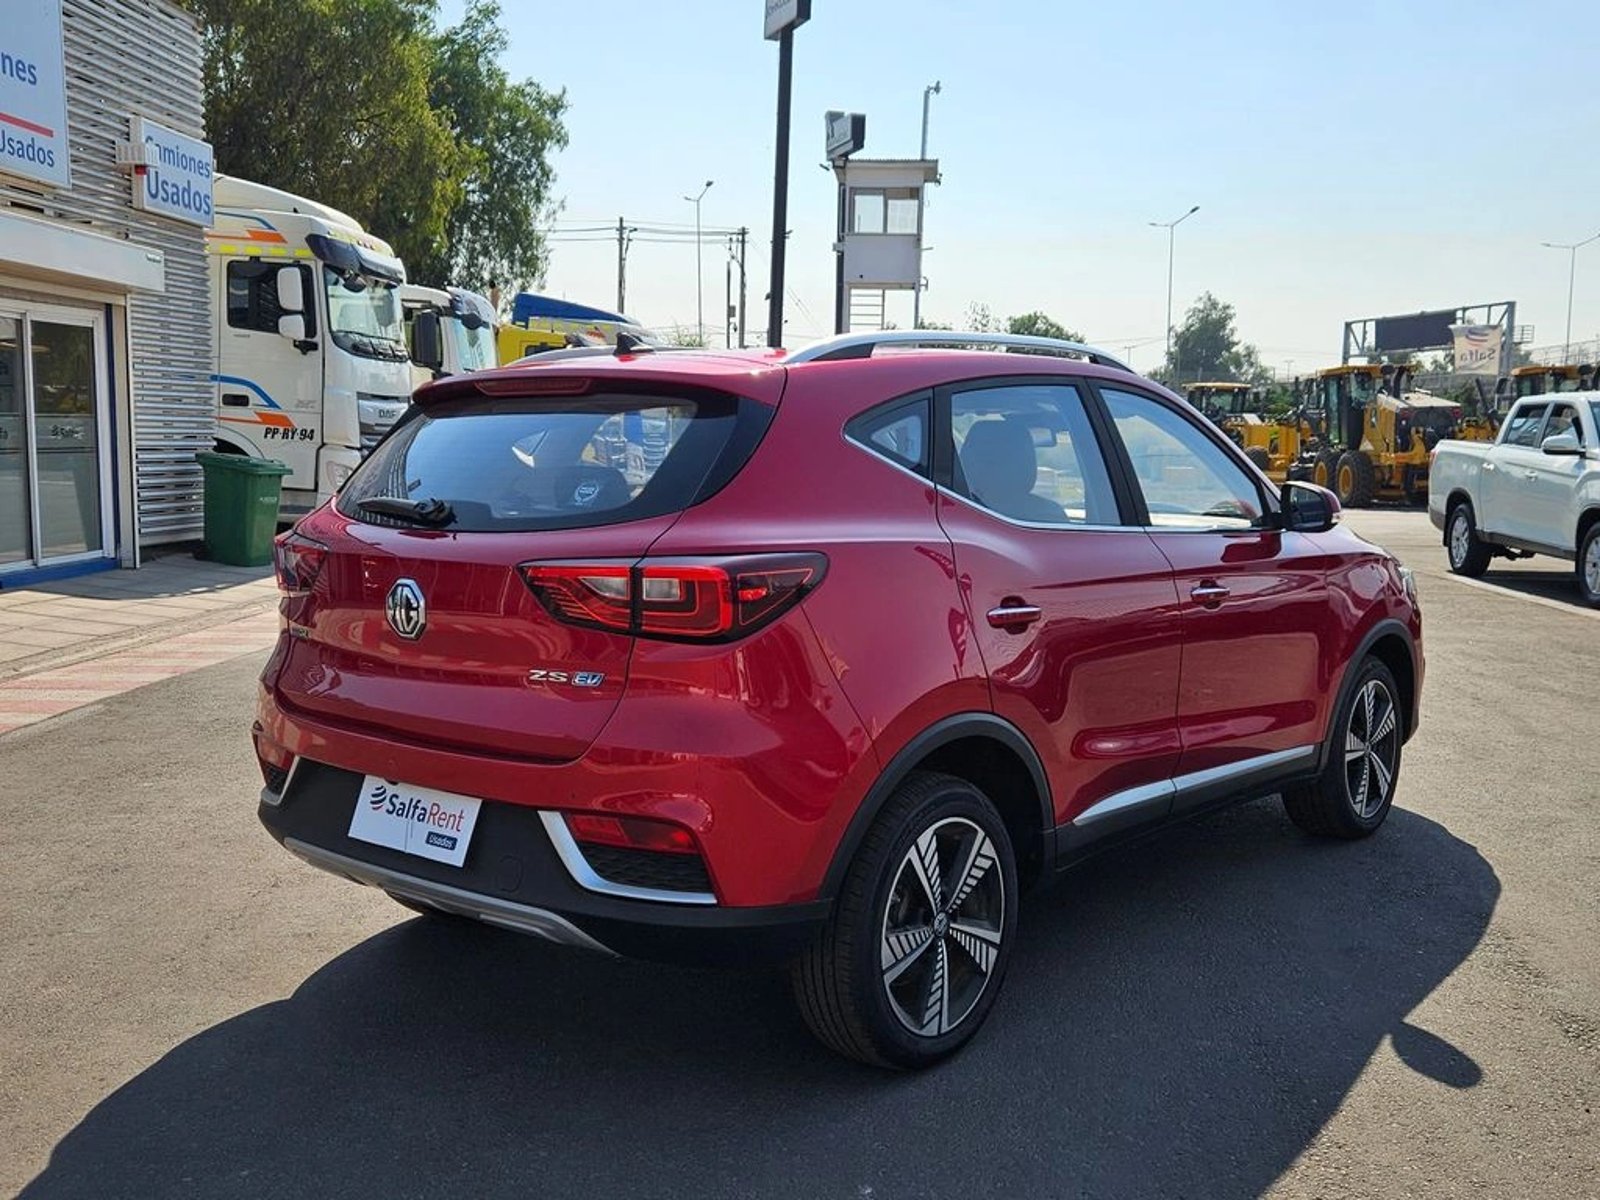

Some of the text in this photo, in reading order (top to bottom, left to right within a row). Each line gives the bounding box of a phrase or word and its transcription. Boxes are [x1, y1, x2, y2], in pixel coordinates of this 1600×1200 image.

[147, 169, 211, 215] Usados
[378, 409, 397, 419] DAF
[388, 581, 421, 635] MG
[529, 669, 603, 685] ZS EV
